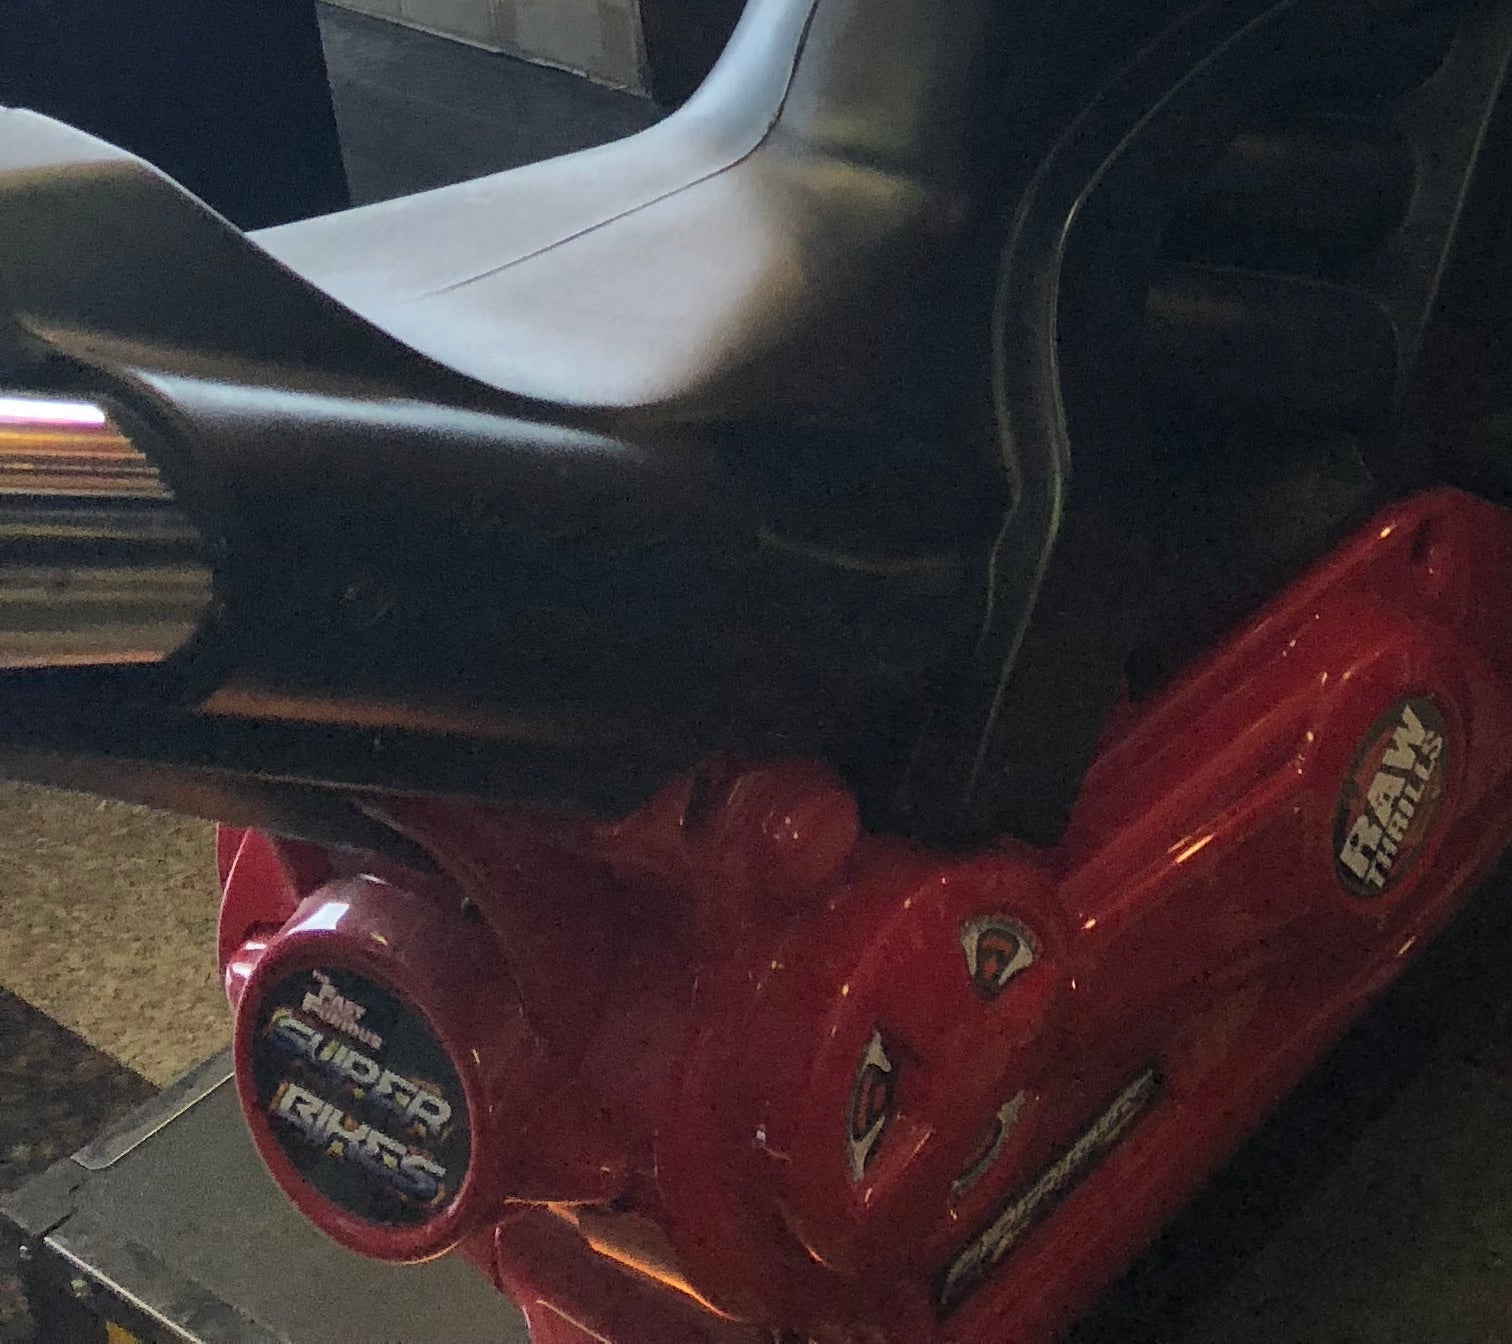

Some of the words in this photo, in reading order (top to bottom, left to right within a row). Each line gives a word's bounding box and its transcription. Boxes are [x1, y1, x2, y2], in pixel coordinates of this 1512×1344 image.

[1340, 704, 1426, 879] RAW
[1365, 730, 1443, 889] THRILLS
[271, 1016, 452, 1137] SUPER
[277, 1081, 448, 1199] BIKES
